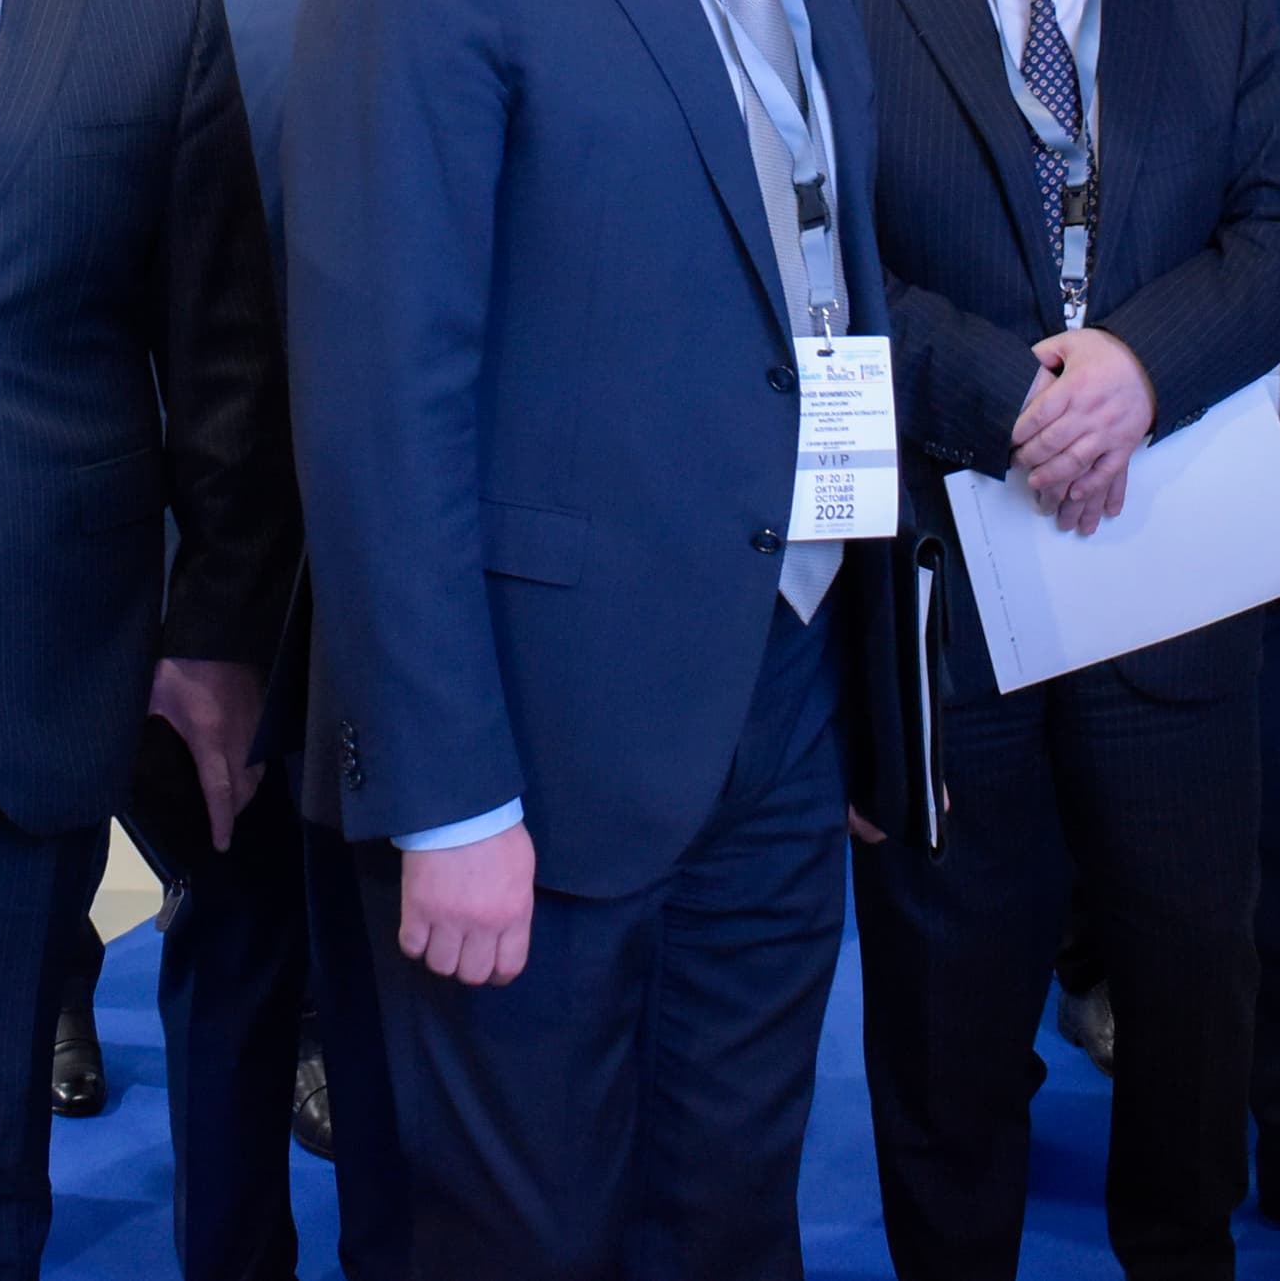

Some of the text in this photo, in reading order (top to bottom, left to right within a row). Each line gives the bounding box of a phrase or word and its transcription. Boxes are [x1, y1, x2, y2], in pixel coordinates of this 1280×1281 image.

[818, 454, 850, 467] VIP
[815, 473, 855, 484] 19 20 21
[815, 485, 855, 494] OKTYABR
[815, 494, 855, 503] OCTOBER
[815, 504, 855, 520] 2022
